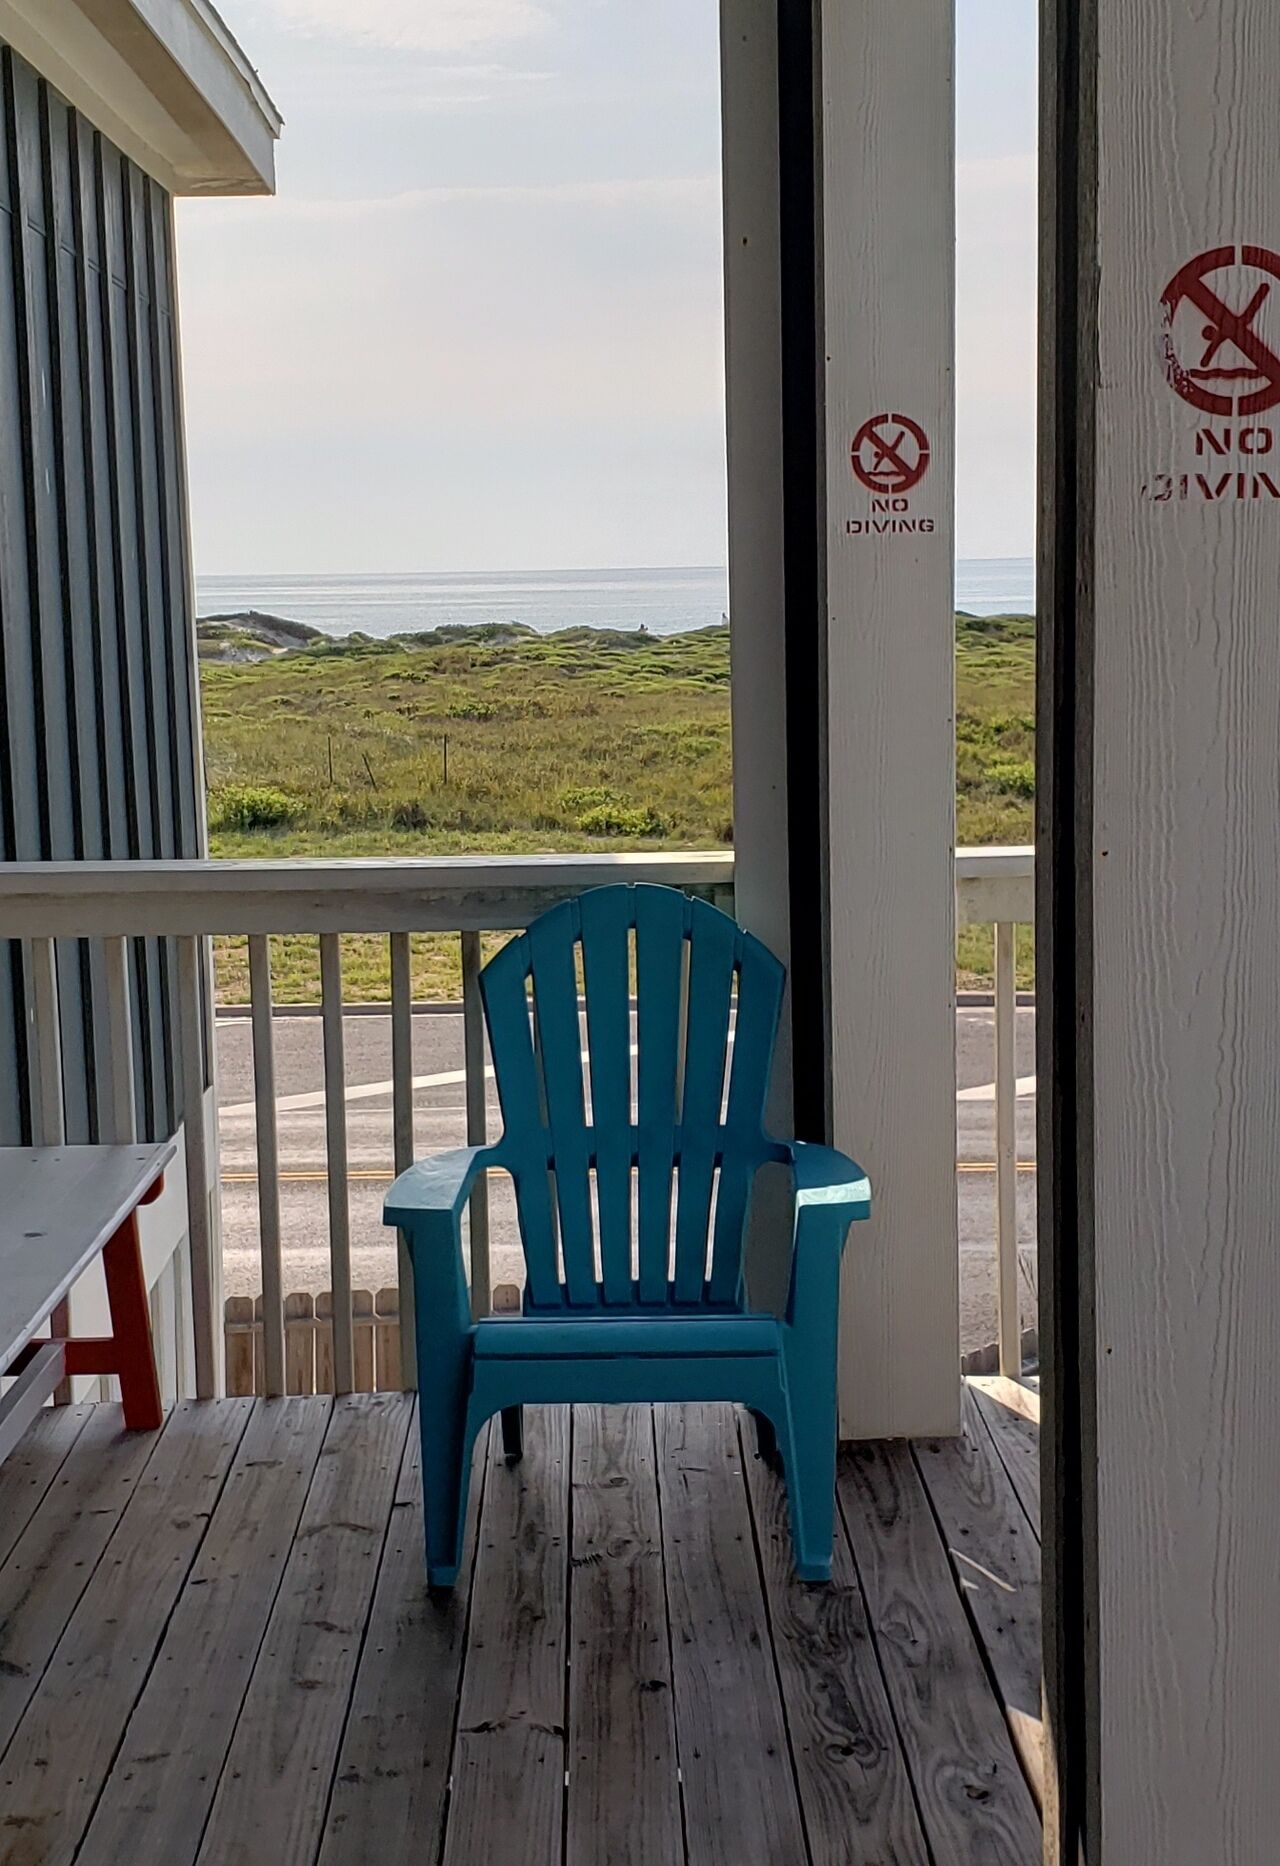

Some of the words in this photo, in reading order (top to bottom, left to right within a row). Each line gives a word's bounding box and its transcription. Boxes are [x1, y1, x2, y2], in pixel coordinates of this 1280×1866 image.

[1195, 427, 1273, 455] NO
[872, 499, 908, 512] NO
[847, 519, 934, 533] DIVING
